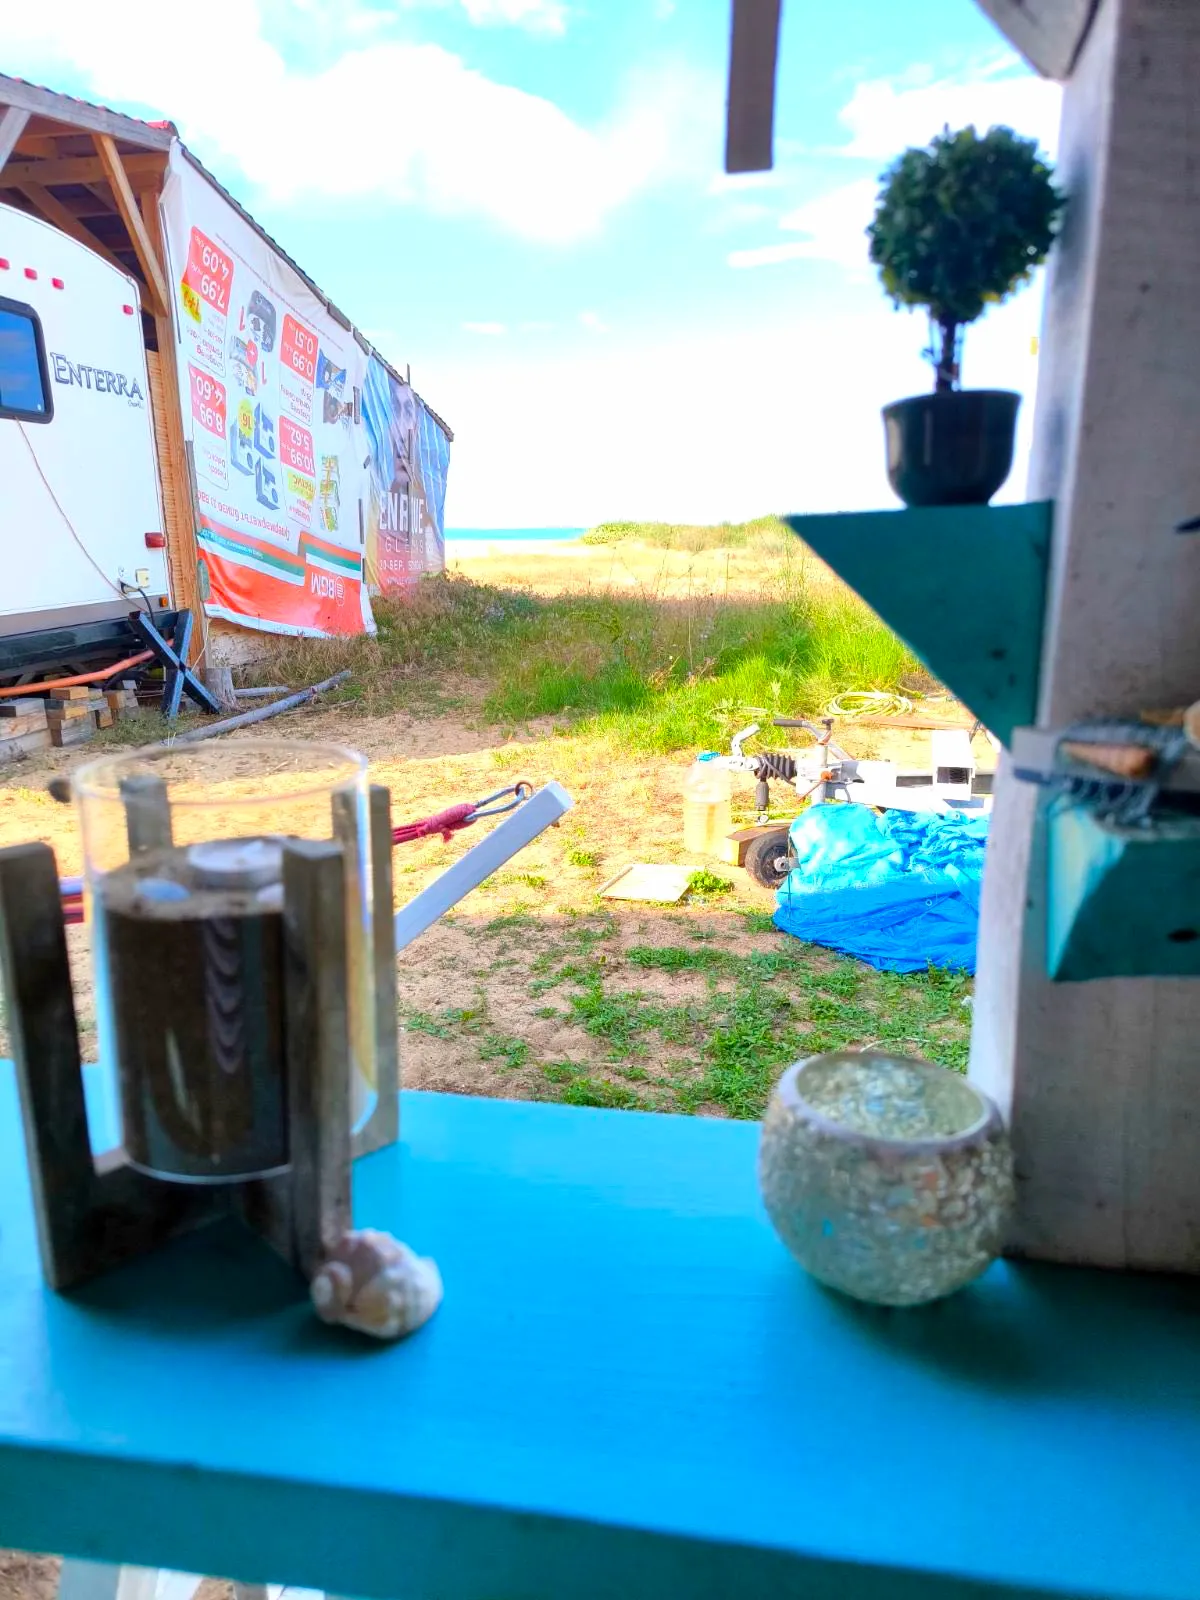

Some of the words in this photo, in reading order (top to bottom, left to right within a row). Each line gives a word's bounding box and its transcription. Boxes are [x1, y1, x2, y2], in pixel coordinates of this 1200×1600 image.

[202, 247, 230, 282] 4.09
[201, 273, 225, 307] 7.99
[50, 352, 144, 401] ENTERRA
[292, 350, 313, 377] 0.99
[196, 374, 224, 405] 4.60
[200, 405, 224, 433] 8.99
[290, 428, 310, 451] 5.62
[311, 572, 335, 600] BGM
